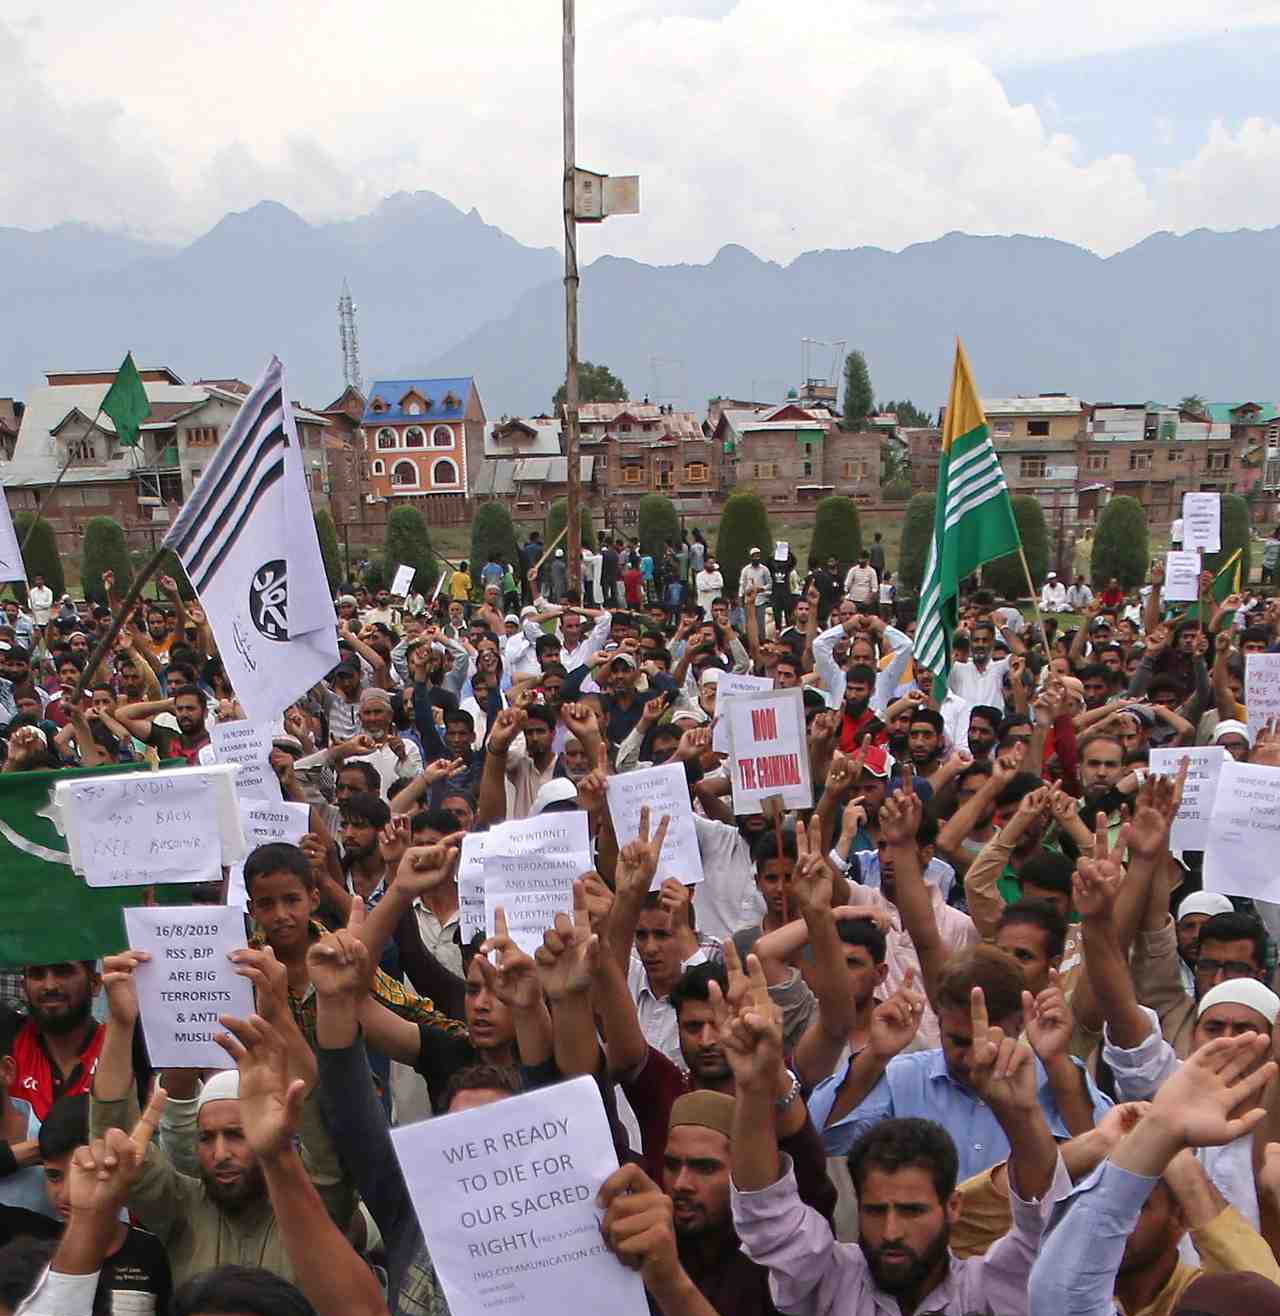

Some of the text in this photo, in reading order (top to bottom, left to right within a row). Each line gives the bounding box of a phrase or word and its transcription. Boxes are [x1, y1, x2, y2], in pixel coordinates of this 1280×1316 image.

[757, 753, 801, 789] CRIMINAL
[155, 924, 219, 938] 16/8/2019
[165, 948, 187, 960] RSS
[168, 970, 217, 982] ARE BIG
[160, 990, 232, 1002] TERRORISTS
[176, 1012, 186, 1024] &
[443, 1117, 569, 1164] WE R READY
[458, 1153, 574, 1194] TO DIE FOR
[460, 1184, 591, 1229] OUR SACRED
